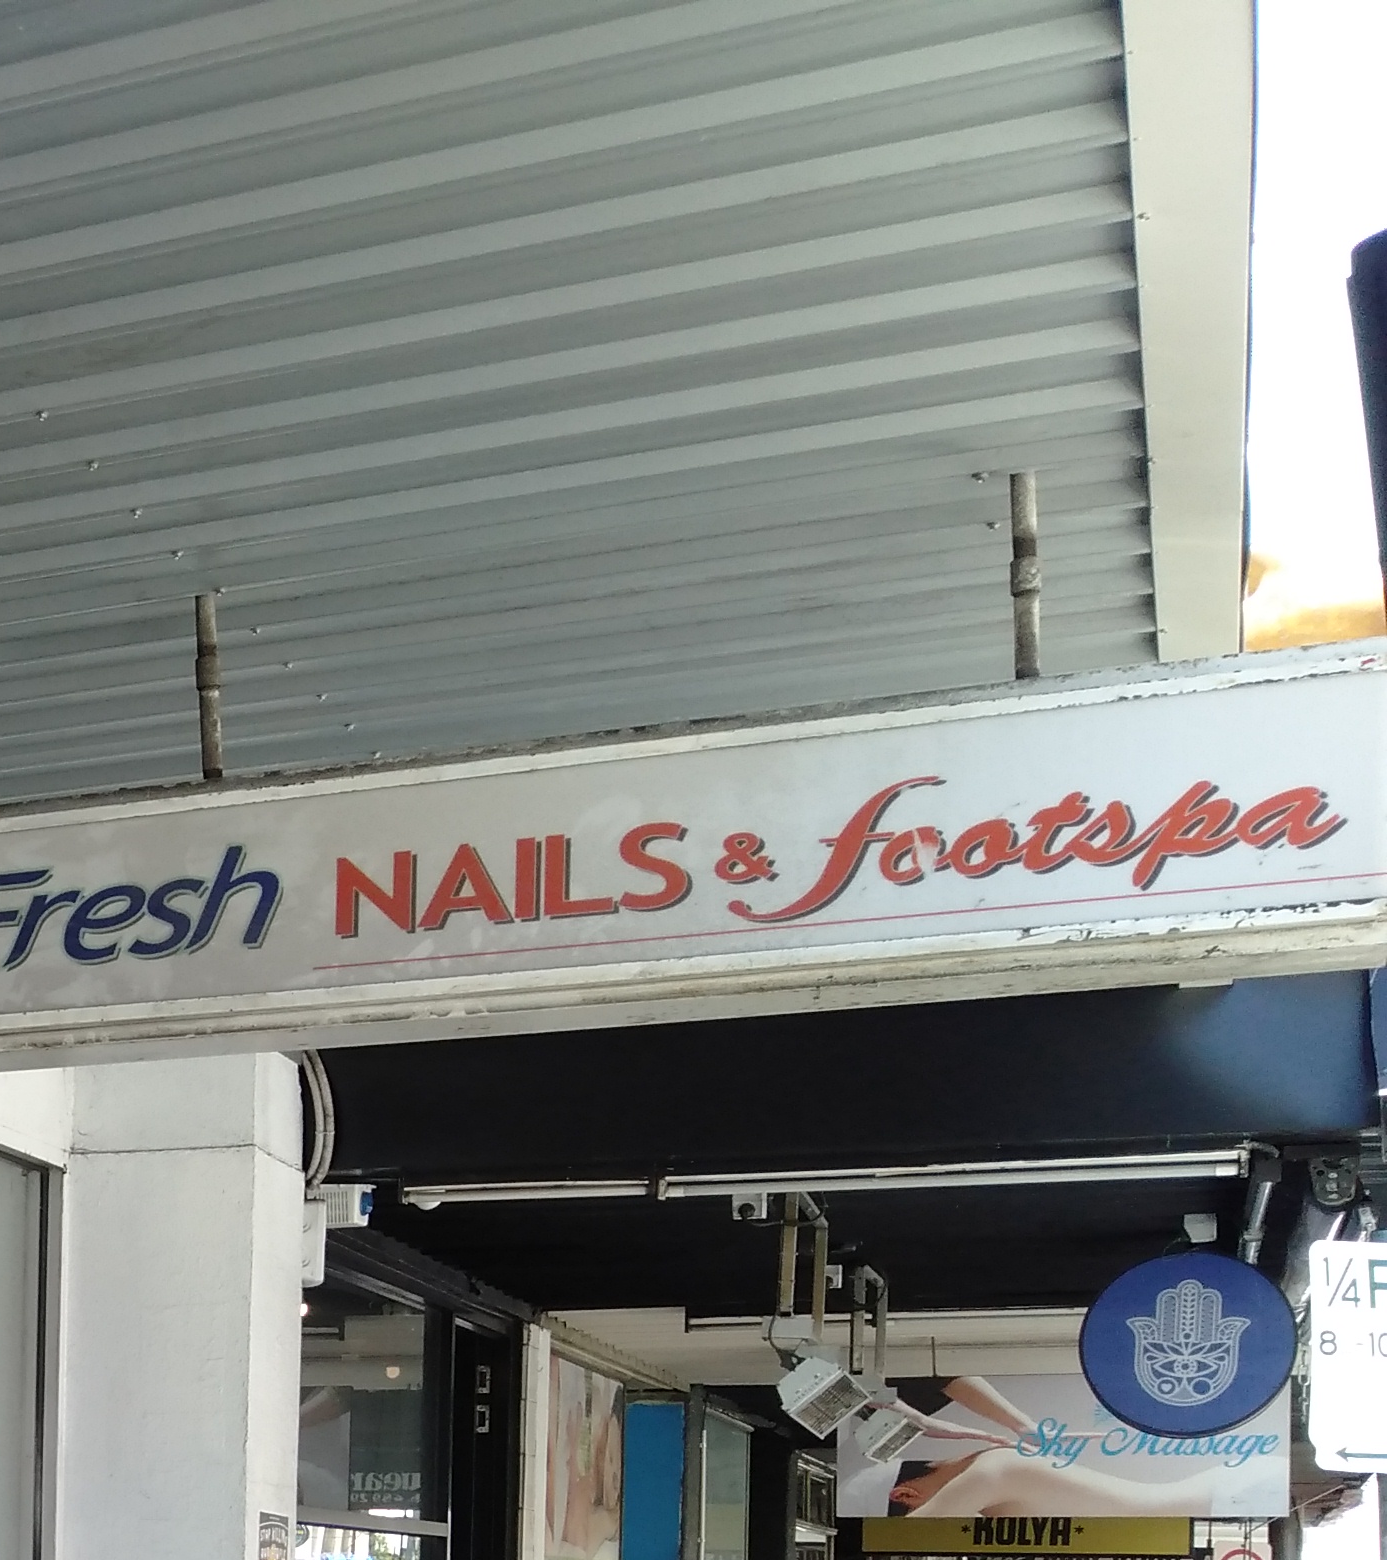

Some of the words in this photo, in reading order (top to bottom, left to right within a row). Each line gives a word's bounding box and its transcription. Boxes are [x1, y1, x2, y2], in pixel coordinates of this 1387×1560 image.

[333, 822, 692, 939] NAILS
[713, 831, 778, 885] &
[729, 774, 1348, 927] footspa
[1016, 1417, 1090, 1469] Sky
